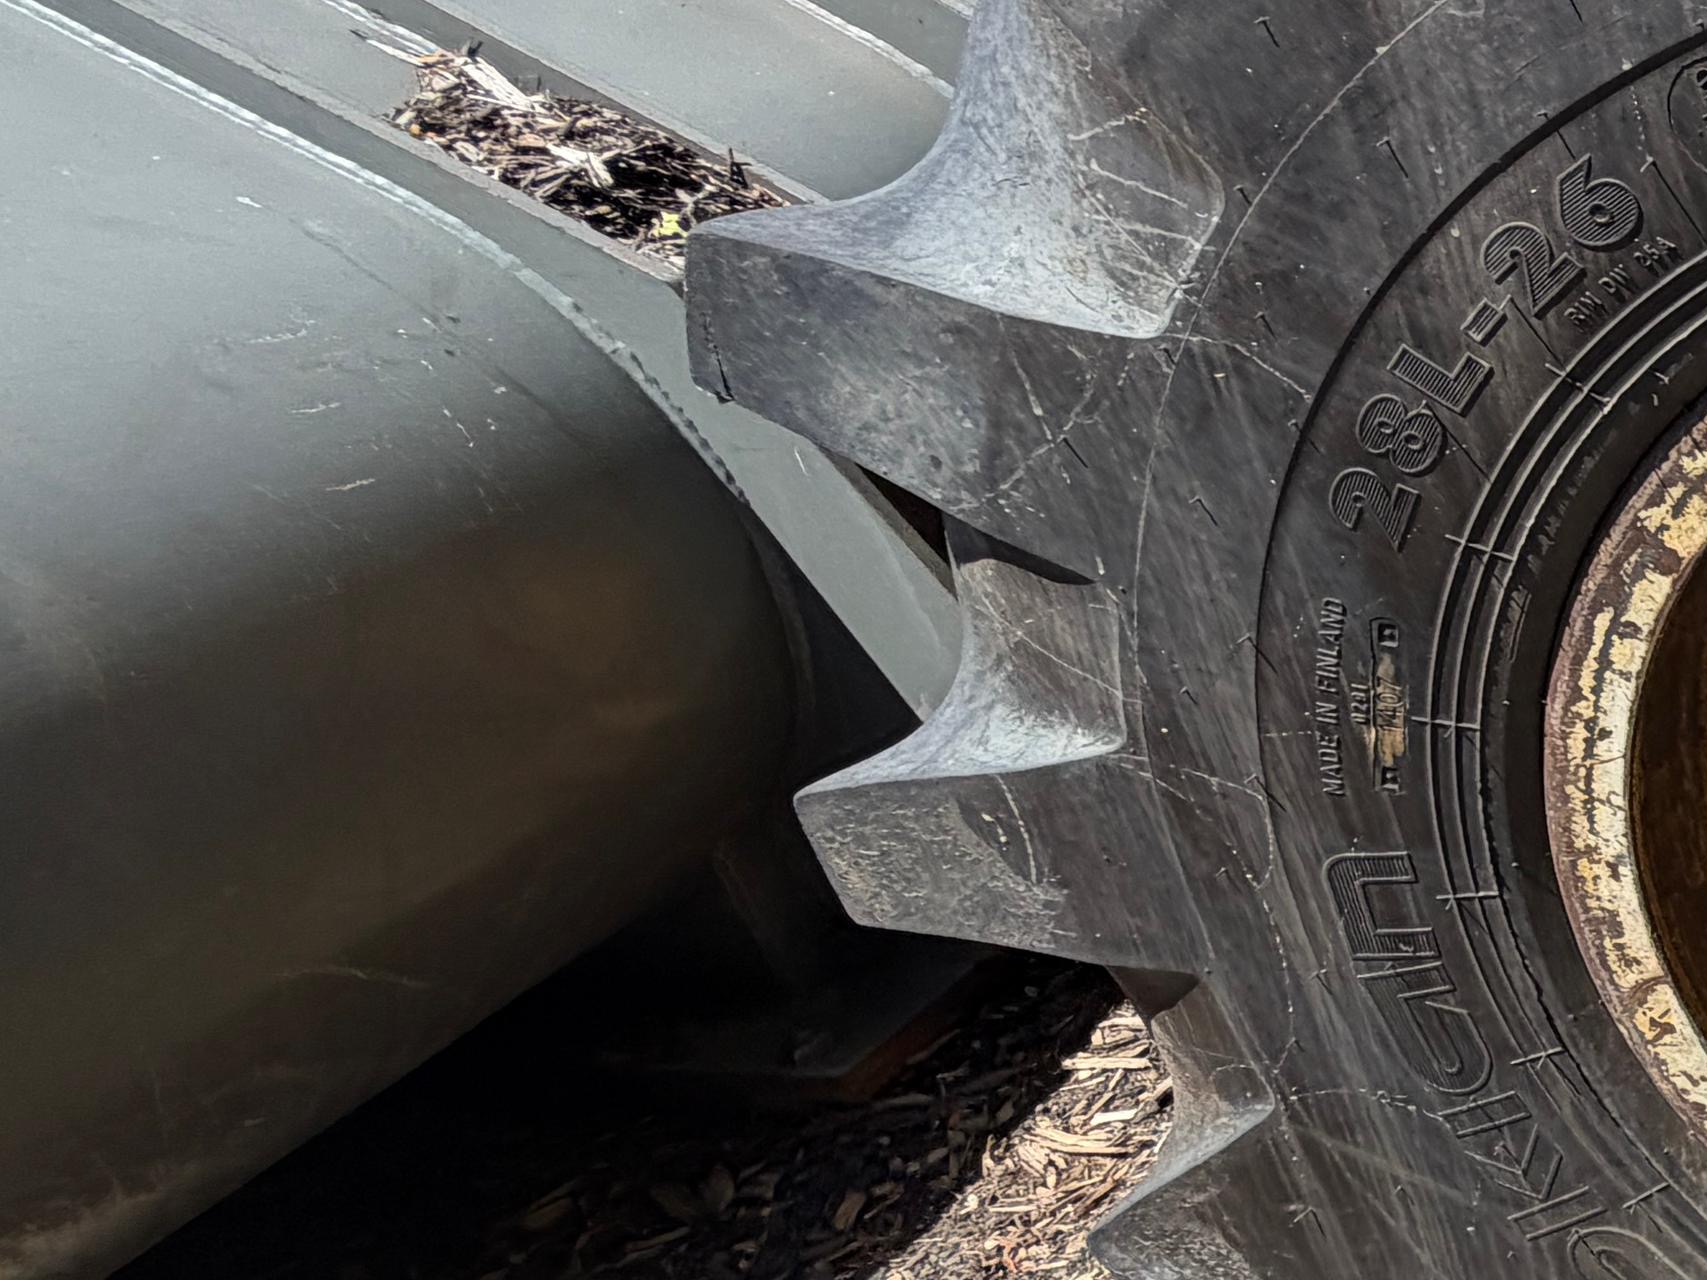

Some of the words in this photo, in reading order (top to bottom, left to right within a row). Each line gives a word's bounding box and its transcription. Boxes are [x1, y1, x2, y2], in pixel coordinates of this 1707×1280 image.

[1563, 290, 1603, 325] RIM
[1328, 153, 1644, 552] 28L-26
[1315, 596, 1347, 694] FINLAND
[1316, 701, 1339, 725] IN
[1376, 675, 1403, 733] 1407
[1315, 730, 1346, 797] MADE
